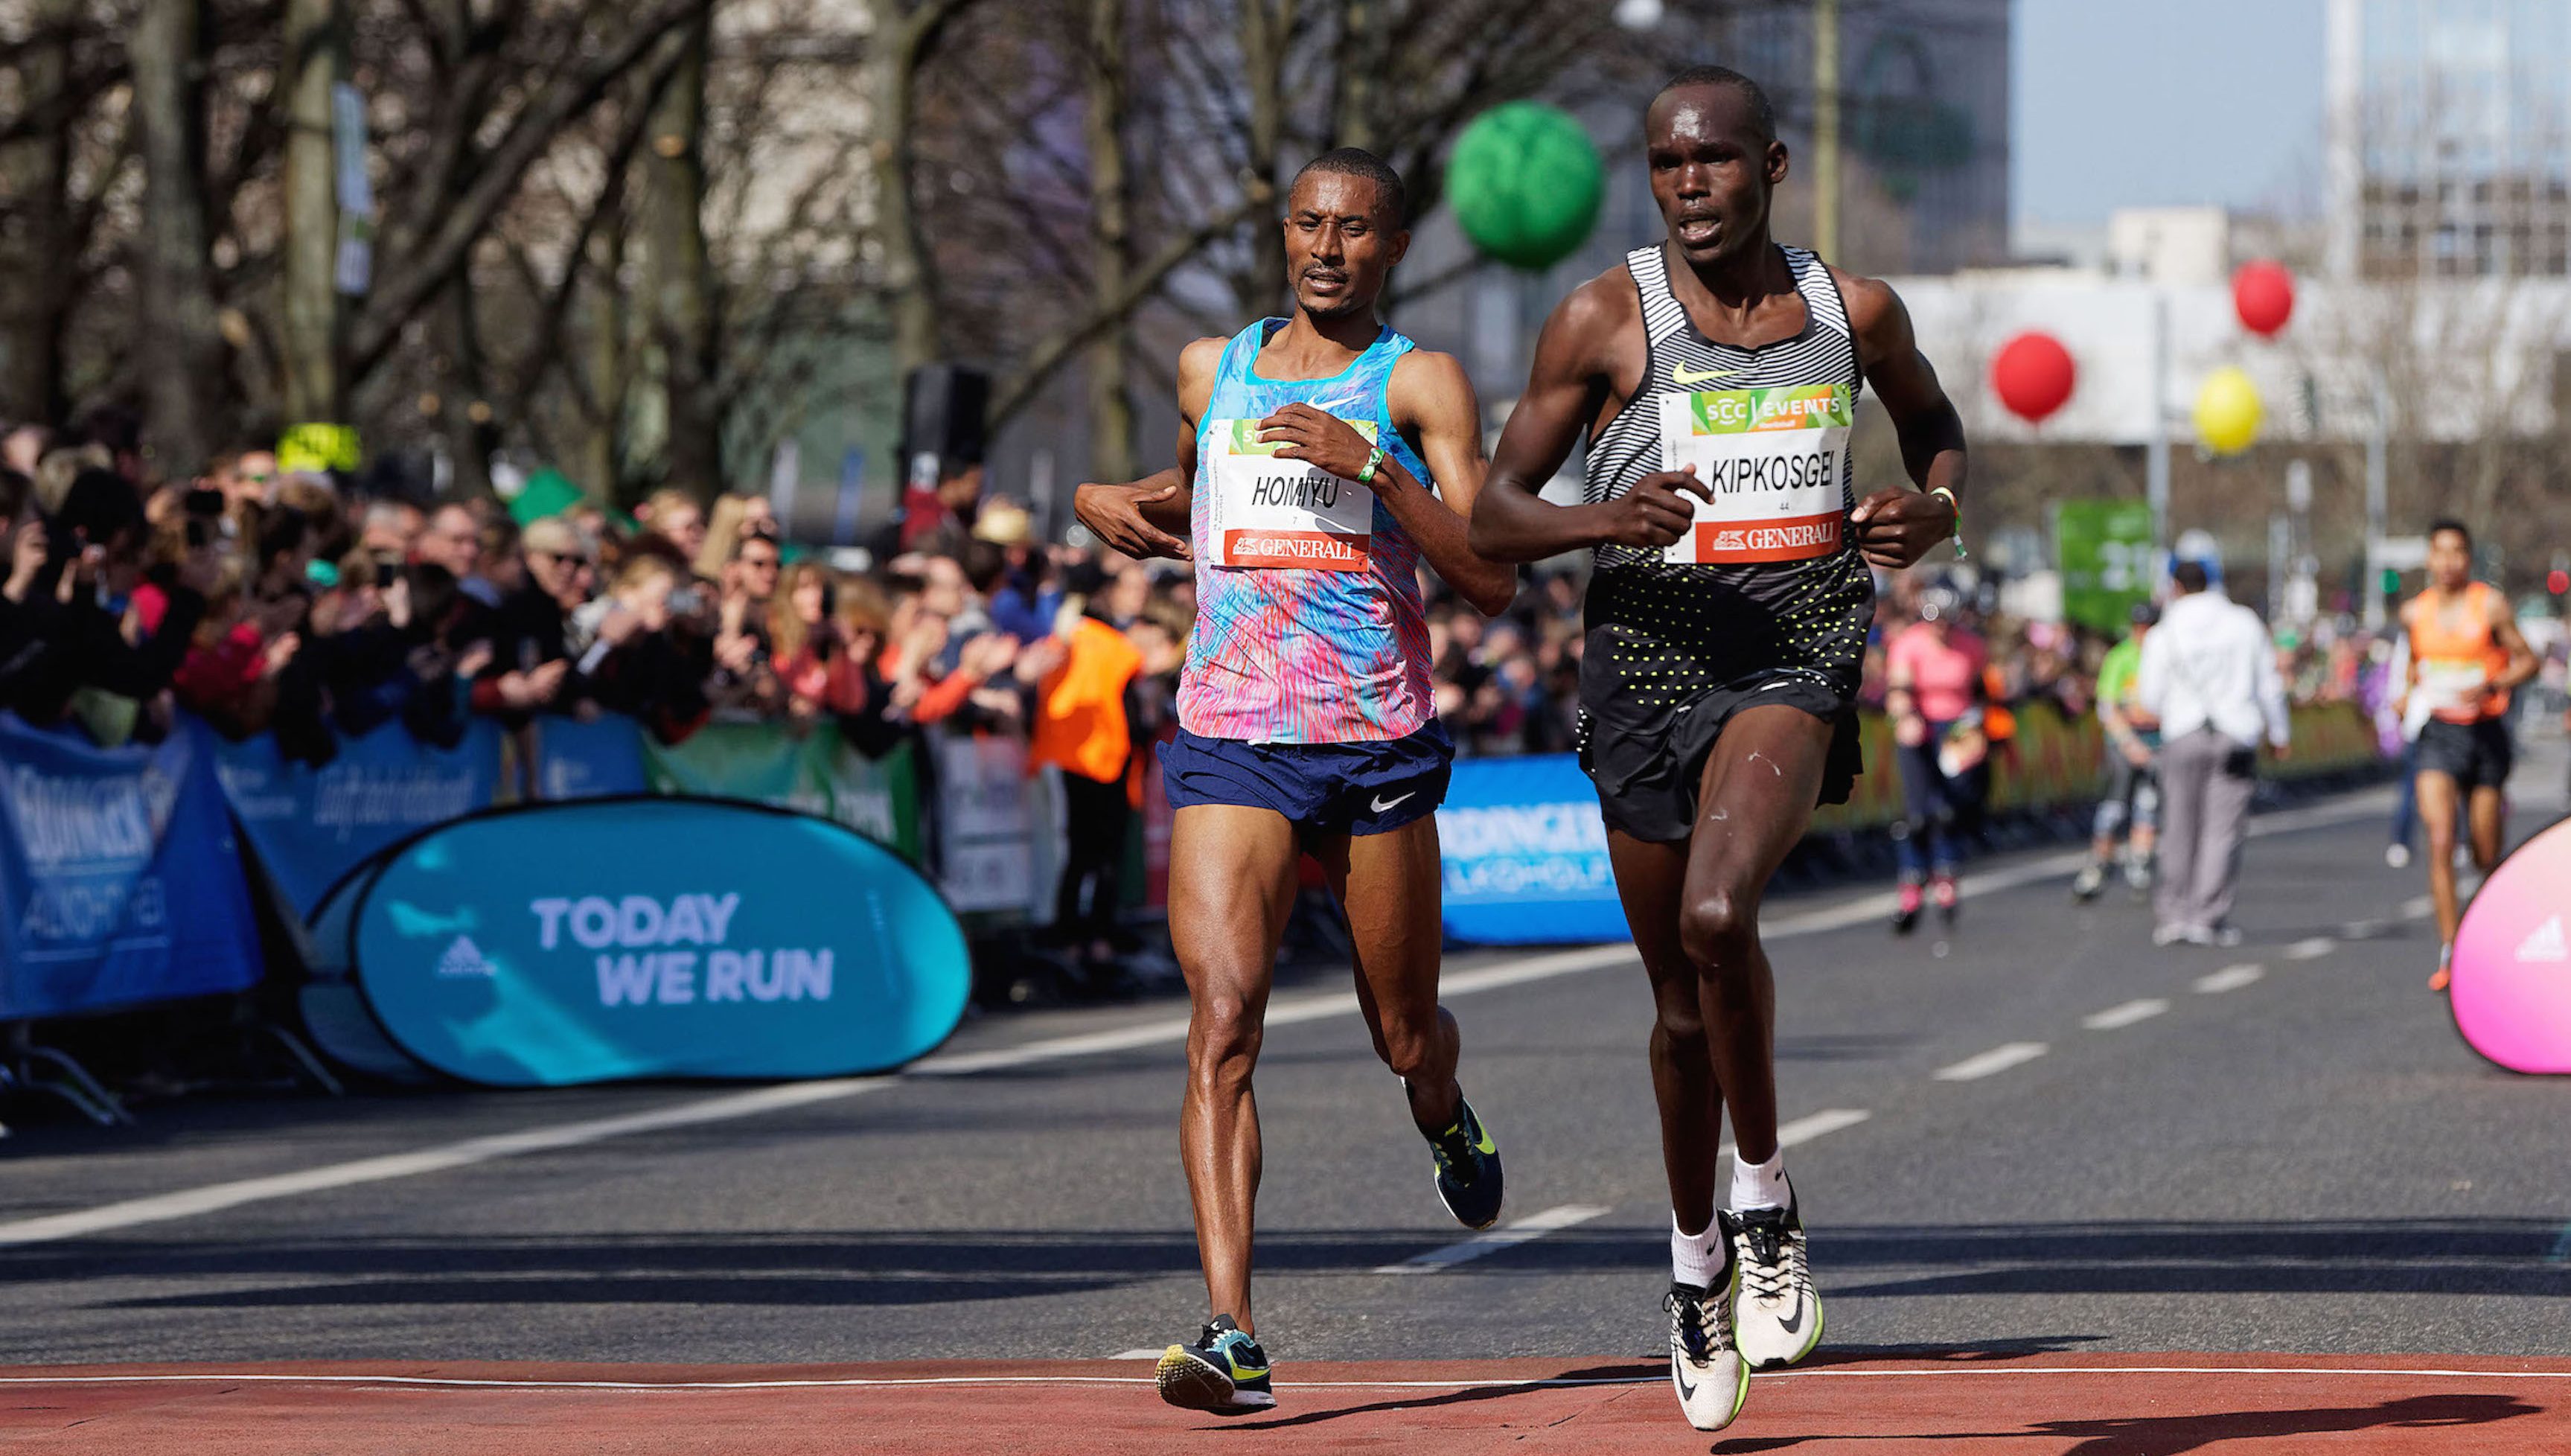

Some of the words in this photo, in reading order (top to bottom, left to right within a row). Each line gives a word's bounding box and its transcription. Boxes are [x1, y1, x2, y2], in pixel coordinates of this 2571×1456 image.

[1707, 402, 1746, 421] SCC
[1762, 397, 1840, 418] EVENTS
[1711, 450, 1835, 494] KIPKOSGEI
[1251, 476, 1340, 509] HOMIYU
[1259, 537, 1356, 561] GENERALI
[1746, 522, 1834, 550] GENERALI
[529, 893, 741, 951] TODAY
[596, 952, 696, 1006] WE
[704, 948, 834, 1003] RUN
